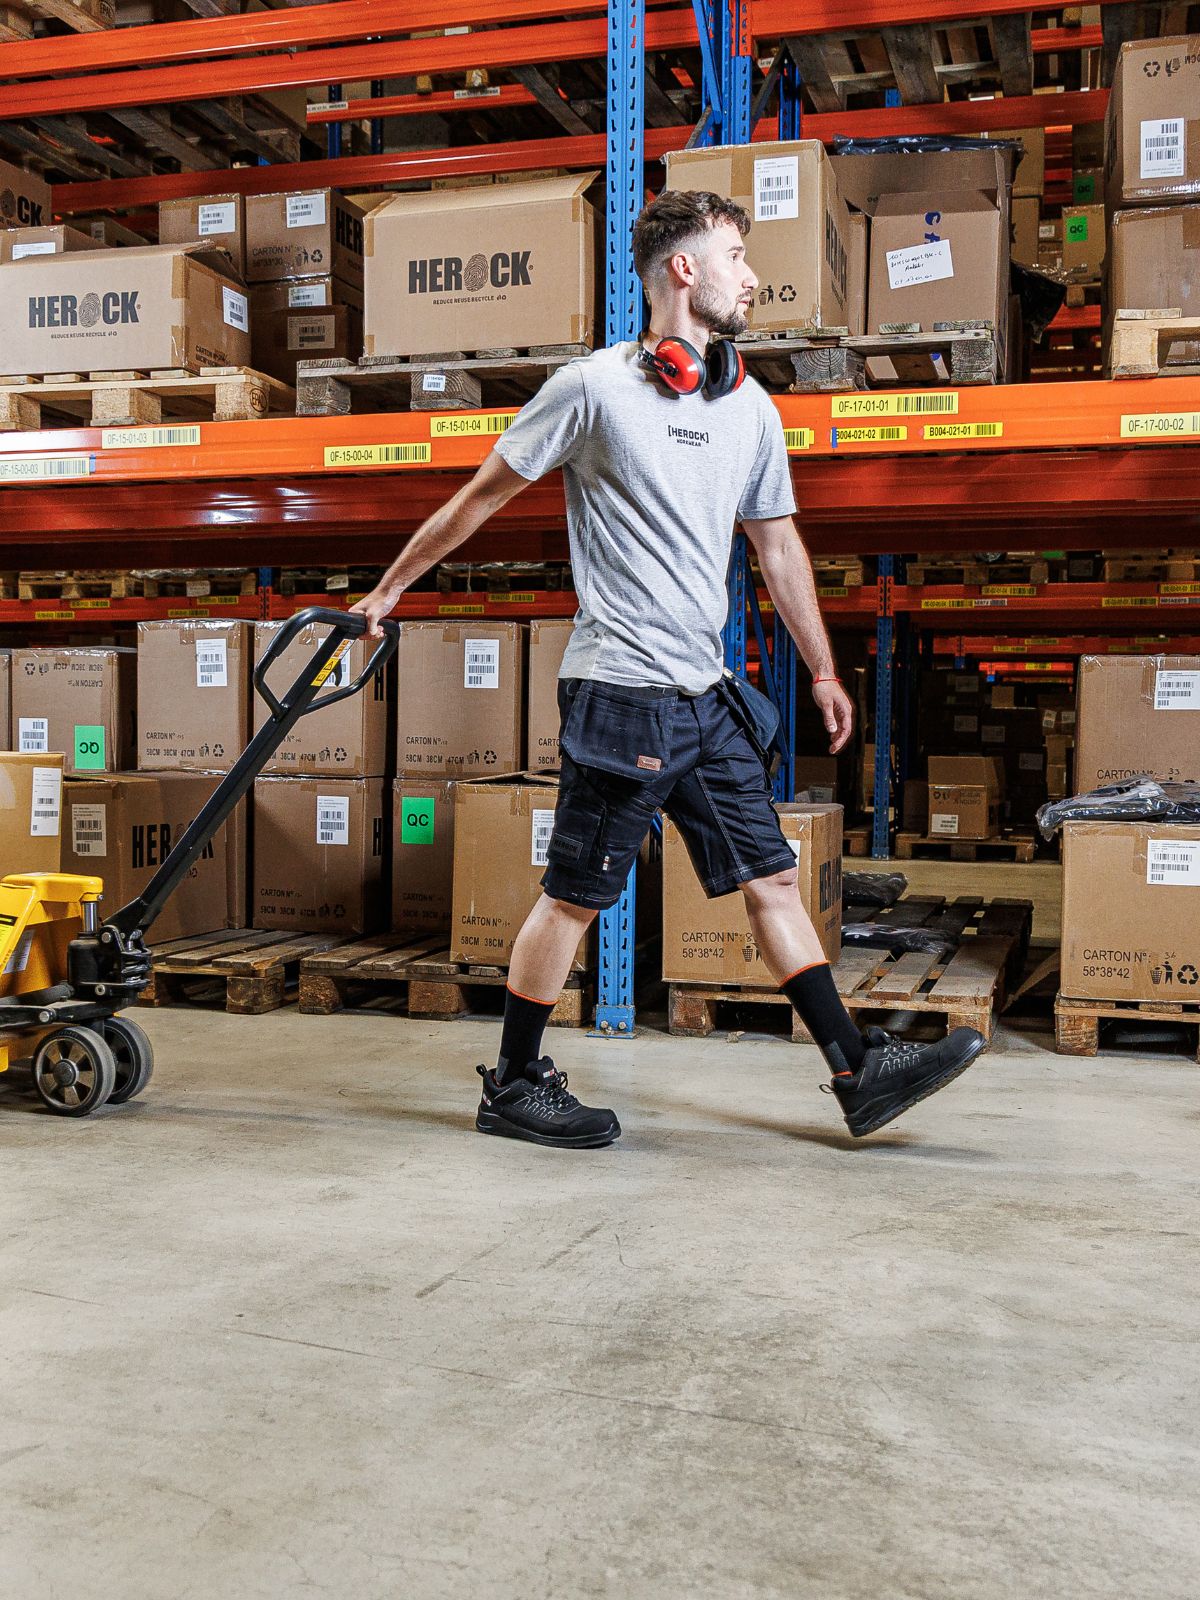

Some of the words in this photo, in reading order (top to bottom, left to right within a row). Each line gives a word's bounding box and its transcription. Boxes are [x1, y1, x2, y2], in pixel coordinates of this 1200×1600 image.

[1077, 185, 1091, 193] QC
[1069, 224, 1084, 234] QC
[252, 245, 283, 257] CARTON
[408, 250, 532, 294] HEROCK
[471, 295, 494, 303] RECYCLE
[28, 290, 140, 328] HEROCK
[929, 425, 971, 437] B004-021-01
[80, 679, 103, 687] CARTON
[146, 731, 168, 740] CARTON
[405, 736, 432, 745] CARTON
[432, 737, 441, 746] N°
[79, 742, 100, 754] QC
[180, 749, 195, 757] 47CM
[280, 752, 296, 761] 38CM
[300, 753, 316, 762] 47CM
[405, 754, 422, 763] 58CM
[426, 754, 443, 764] 38CM
[447, 756, 465, 765] 47CM
[538, 756, 556, 765] 58CM
[407, 813, 430, 828] QC
[260, 888, 285, 897] CARTON
[461, 915, 491, 927] CARTON
[492, 917, 502, 927] N°
[460, 936, 480, 946] 58CM
[484, 937, 504, 948] 38CM
[681, 931, 725, 943] CARTON
[1083, 948, 1131, 962] CARTON
